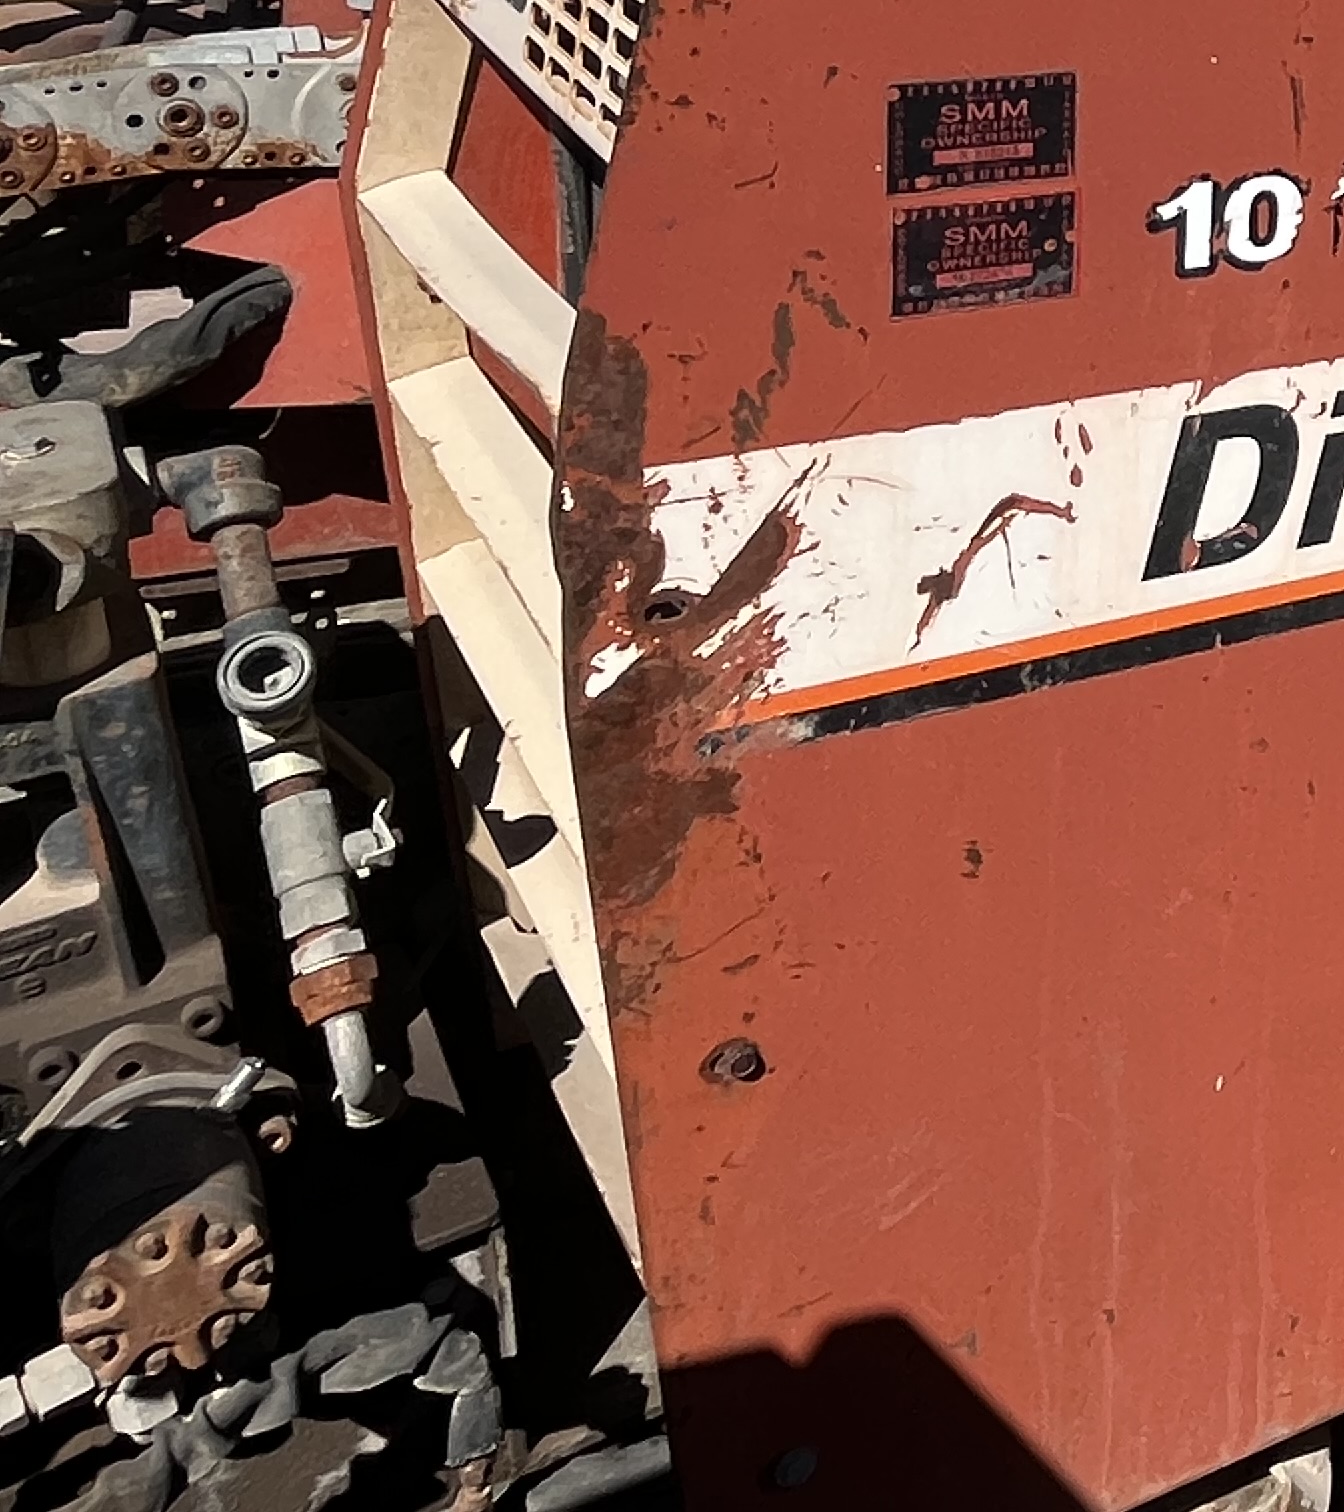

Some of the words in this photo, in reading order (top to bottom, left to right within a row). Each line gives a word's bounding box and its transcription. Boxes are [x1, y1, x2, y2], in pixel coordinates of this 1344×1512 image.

[940, 98, 1029, 123] SMM
[944, 220, 1029, 246] SMM
[1147, 171, 1304, 277] 10
